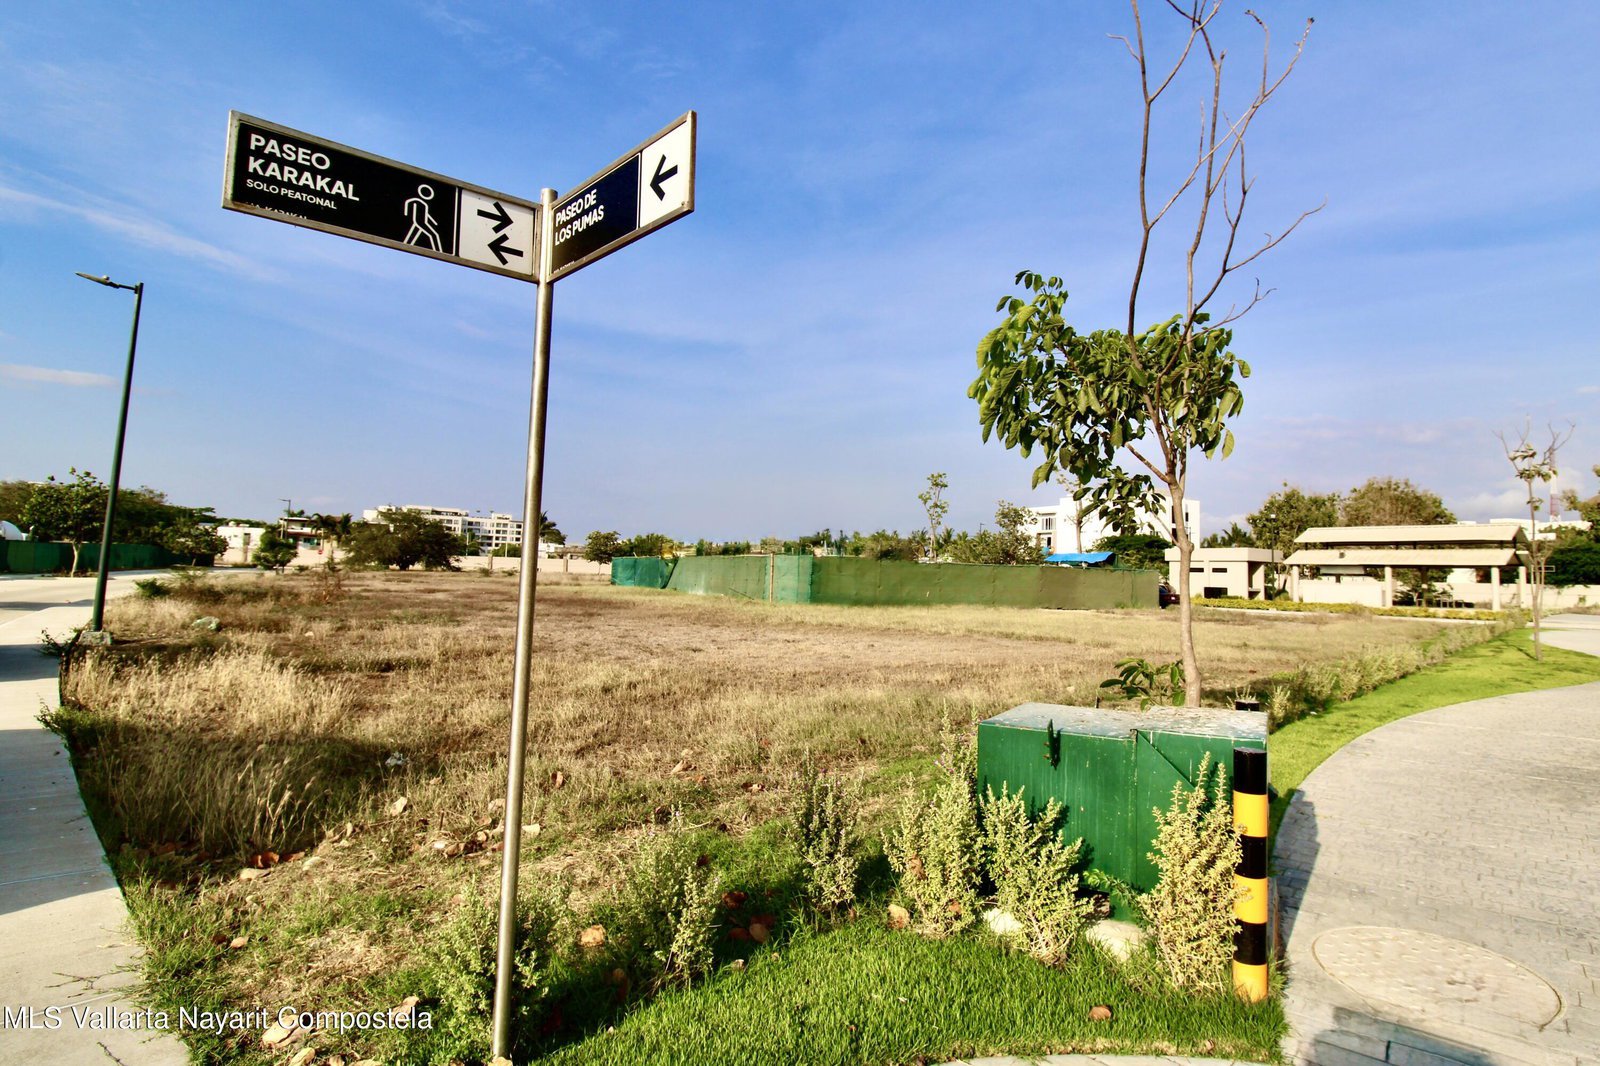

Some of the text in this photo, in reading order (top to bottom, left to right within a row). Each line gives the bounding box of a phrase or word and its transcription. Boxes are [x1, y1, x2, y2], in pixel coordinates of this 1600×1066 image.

[250, 133, 331, 170] PASEO
[246, 179, 338, 210] SOLO PEATONAL
[248, 156, 360, 201] KARAKAL
[555, 189, 597, 227] PASEO DE
[555, 205, 604, 246] LOS PUMAS
